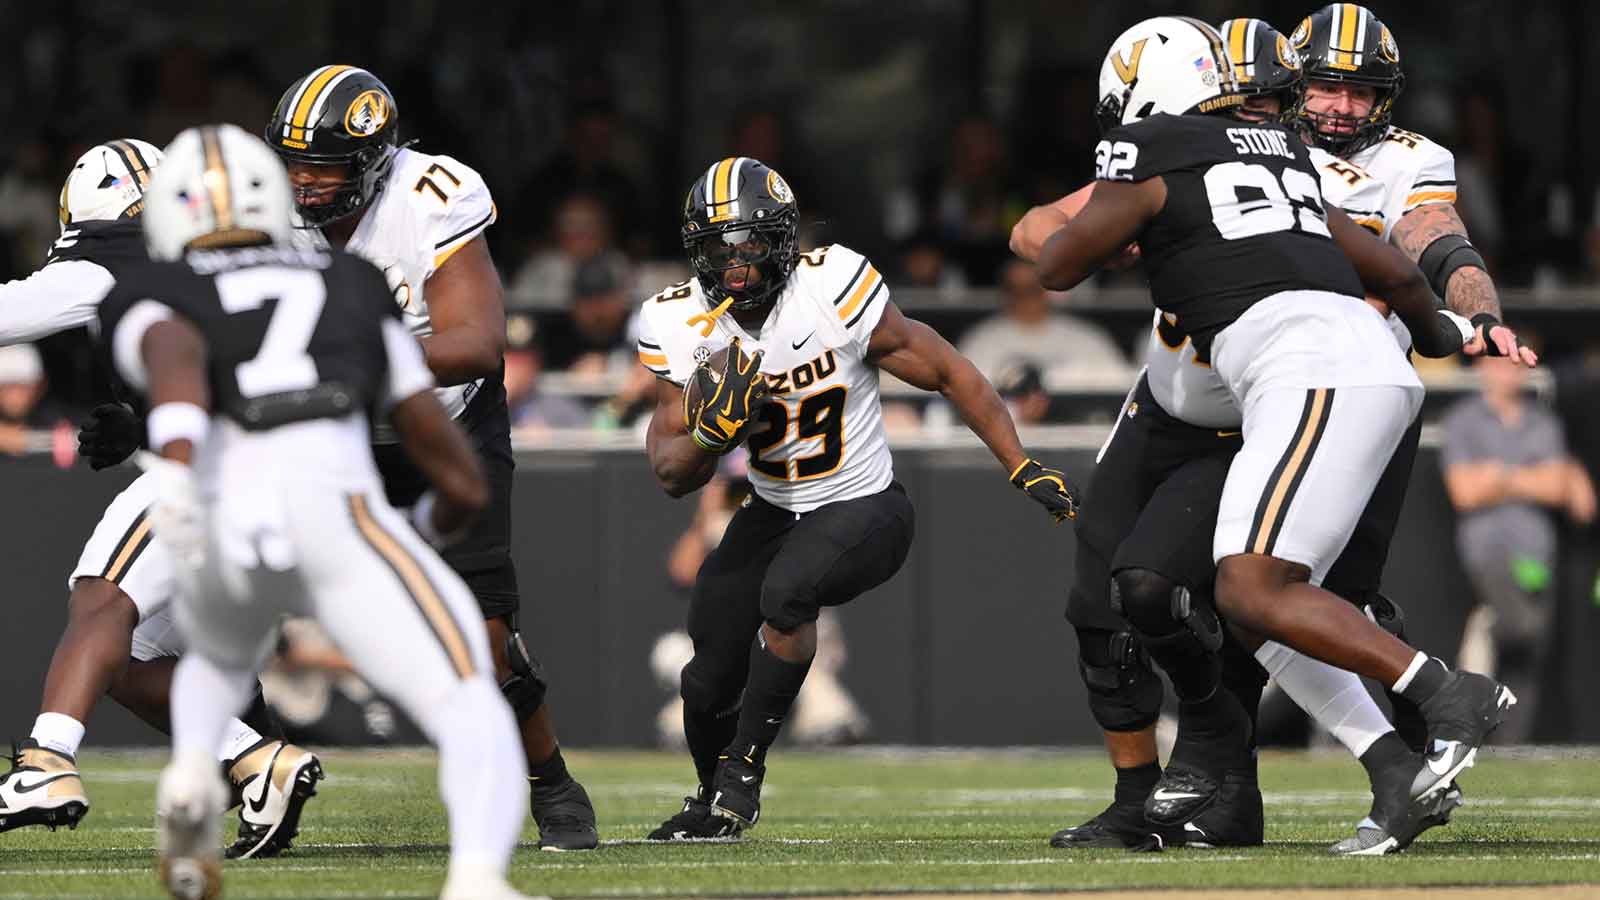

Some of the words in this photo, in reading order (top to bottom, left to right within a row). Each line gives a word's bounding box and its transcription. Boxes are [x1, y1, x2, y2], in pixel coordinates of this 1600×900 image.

[1226, 127, 1296, 160] STONE
[413, 162, 461, 206] 77
[213, 265, 328, 399] 7
[767, 350, 837, 395] ZOU
[750, 383, 849, 481] 29
